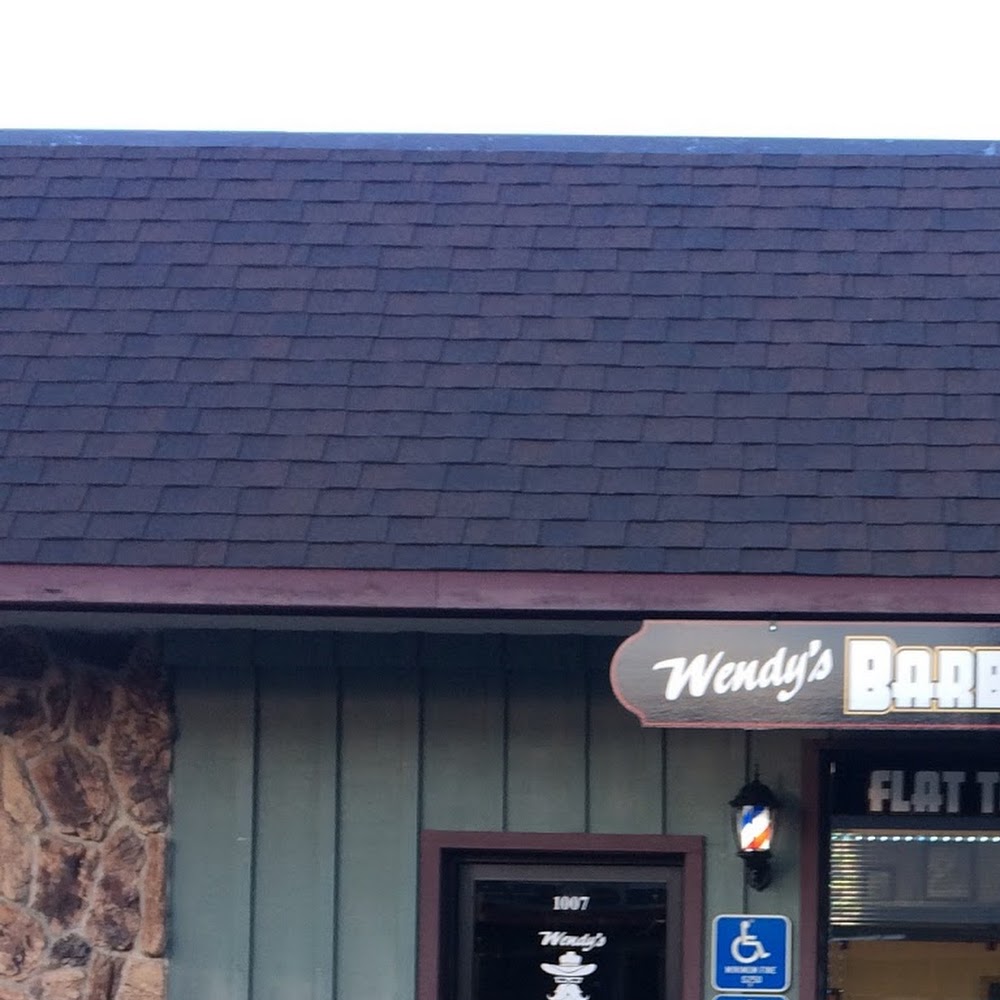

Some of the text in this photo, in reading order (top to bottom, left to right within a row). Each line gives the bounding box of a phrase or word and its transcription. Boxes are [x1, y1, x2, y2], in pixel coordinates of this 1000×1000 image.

[652, 639, 834, 702] Wendy's
[868, 770, 966, 813] FLAT
[552, 896, 590, 910] 1007
[538, 931, 607, 952] Wendy's
